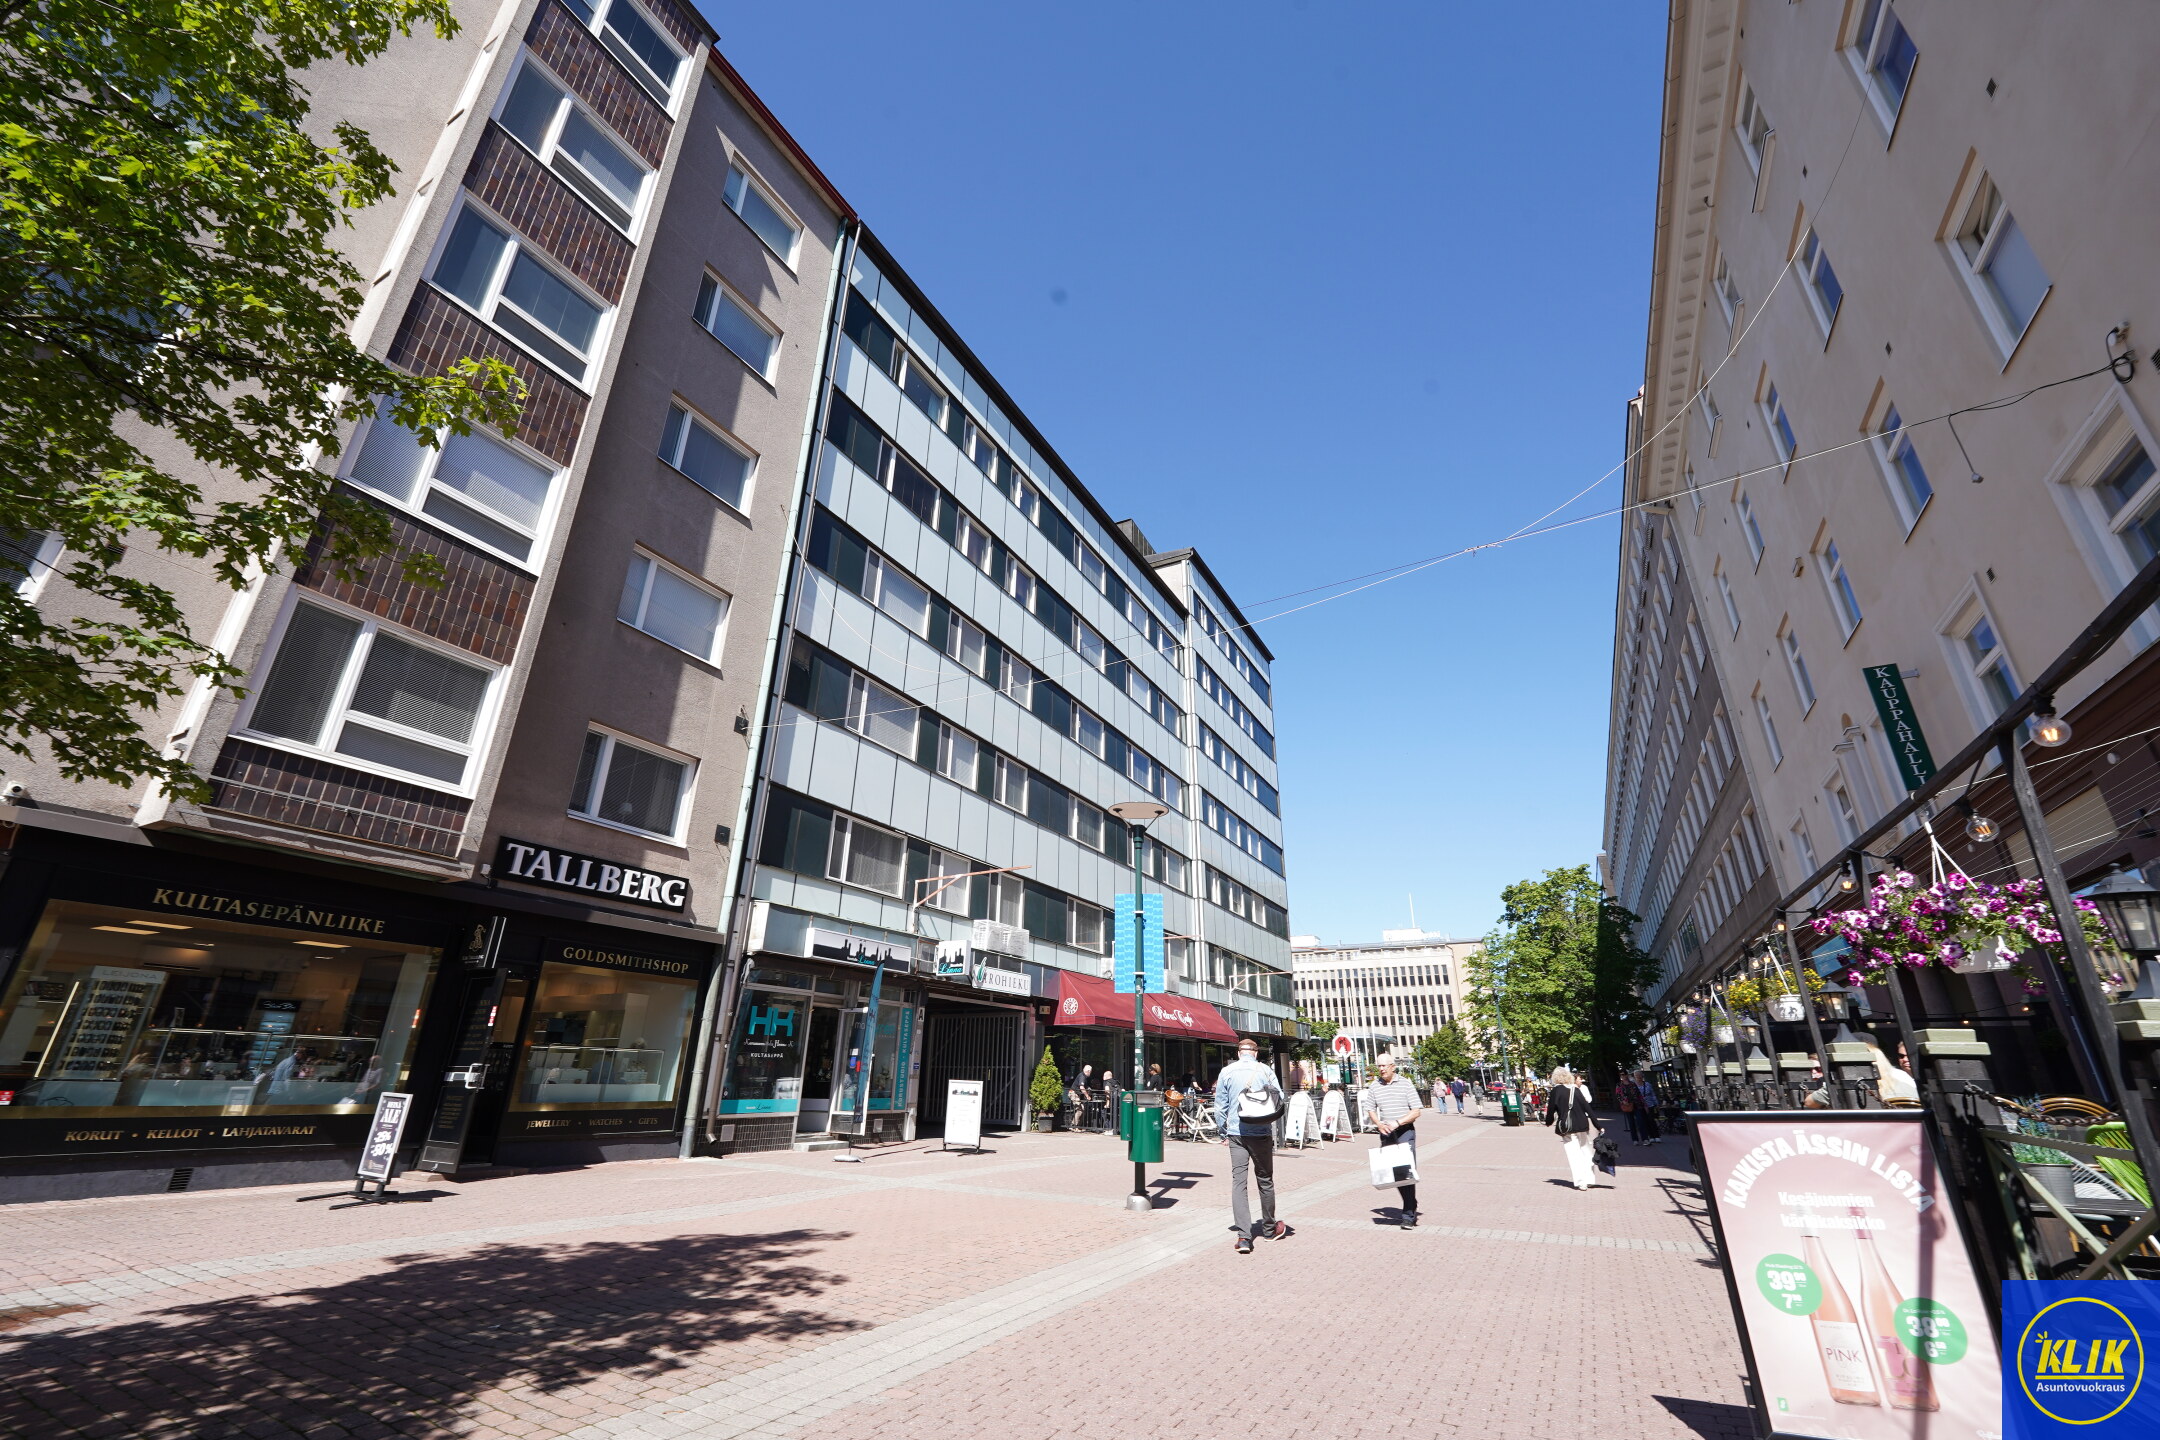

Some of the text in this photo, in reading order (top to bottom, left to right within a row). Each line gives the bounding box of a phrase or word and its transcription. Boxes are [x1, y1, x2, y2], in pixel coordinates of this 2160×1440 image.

[1873, 667, 1927, 786] KAUPPAHALLI
[506, 843, 686, 907] TALLBERG
[152, 888, 386, 934] KULTASEPÄNLIIKE
[563, 947, 689, 974] GOLDSMITHSHOP
[64, 1126, 317, 1141] KORUT KELLOT LAHJATAVARAT
[526, 1117, 659, 1129] JEWELLERY WATCHES GIFTS
[1723, 1129, 1936, 1213] KAIKISTA ÄSSIN LISTA
[1778, 1191, 1876, 1208] Kesäjuomien
[1826, 1347, 1862, 1363] PINK
